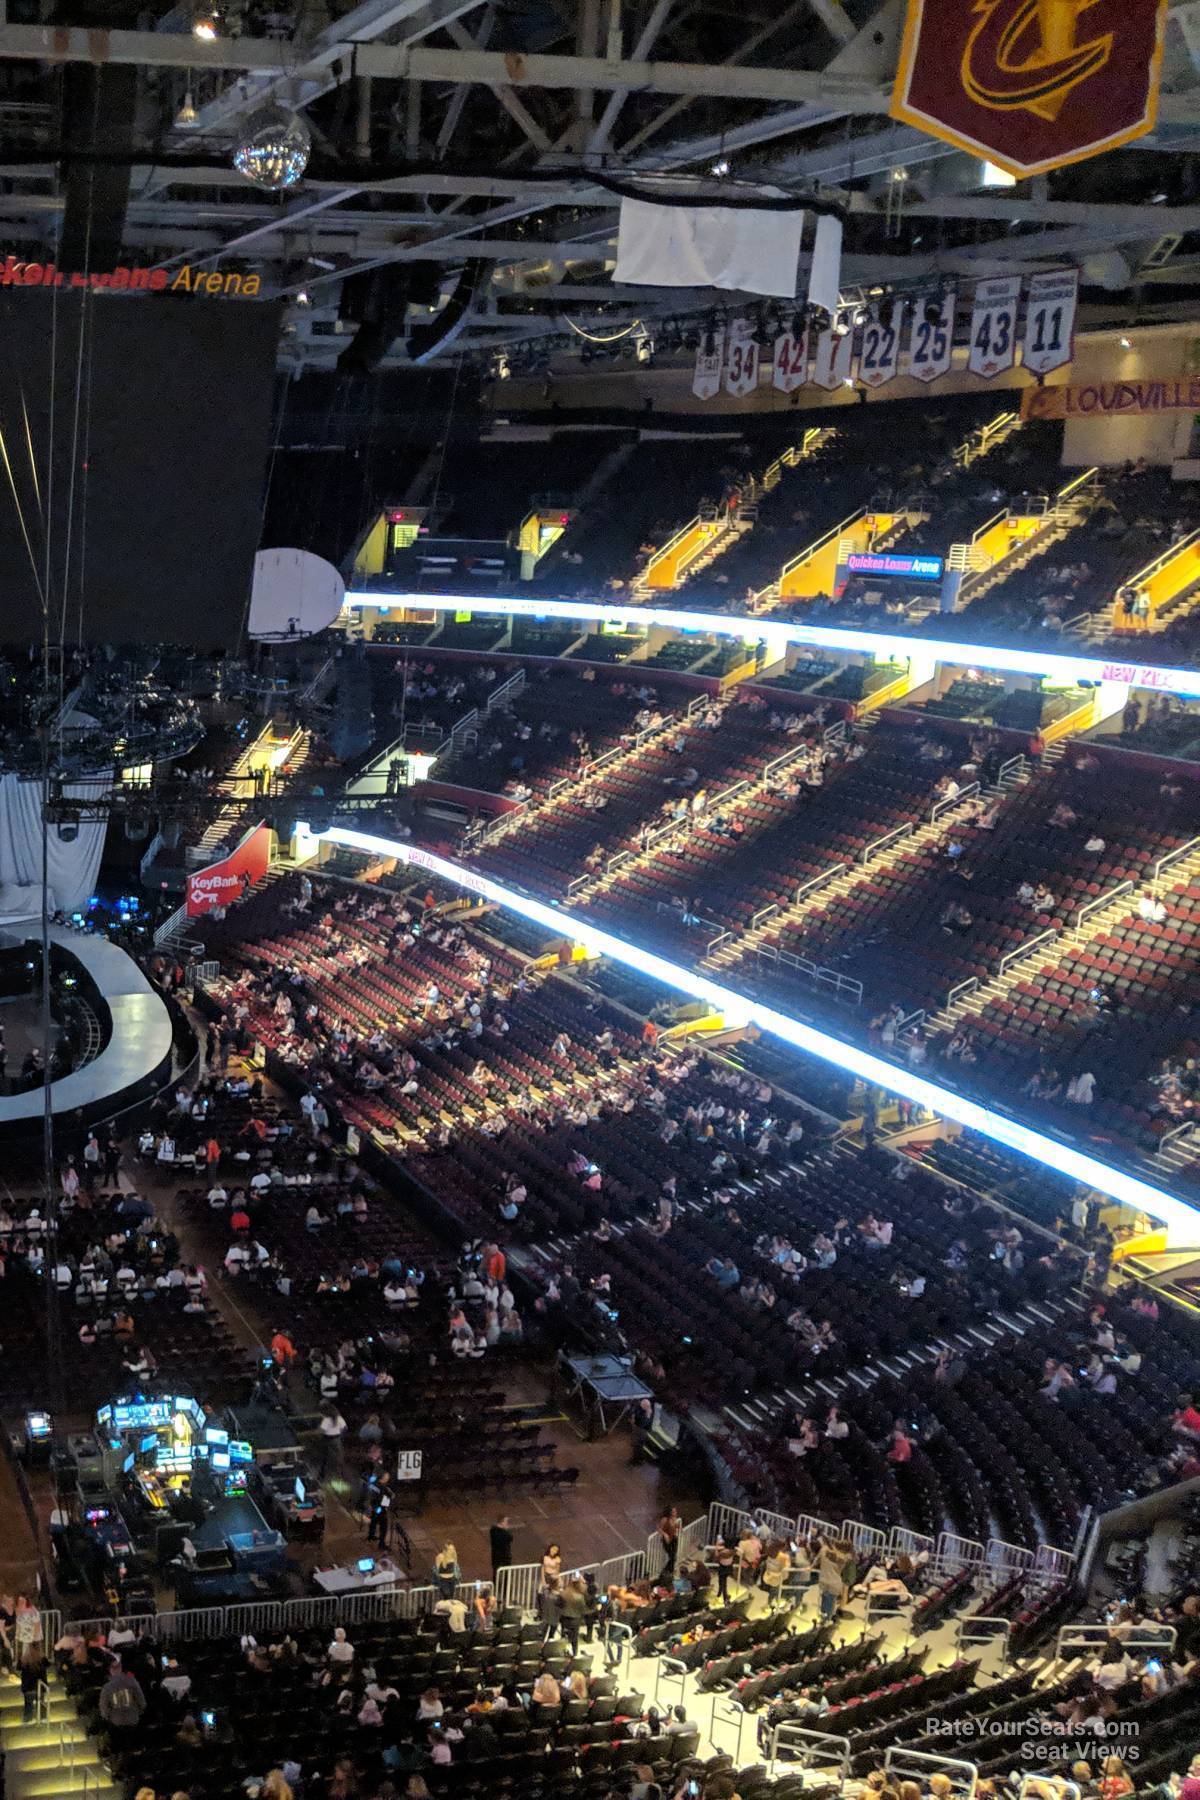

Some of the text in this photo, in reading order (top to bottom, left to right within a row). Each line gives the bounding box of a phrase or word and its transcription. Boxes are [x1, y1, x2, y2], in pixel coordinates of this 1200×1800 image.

[171, 264, 261, 296] Arena
[913, 318, 948, 363] 25
[974, 311, 1012, 357] 43
[1031, 306, 1063, 352] 11
[729, 344, 755, 382] 34
[777, 337, 804, 375] 42
[830, 333, 842, 371] 7
[864, 328, 896, 369] 22
[849, 556, 940, 574] Quicken Loans Arena
[191, 874, 238, 890] KeyBank
[399, 1452, 421, 1469] FL6
